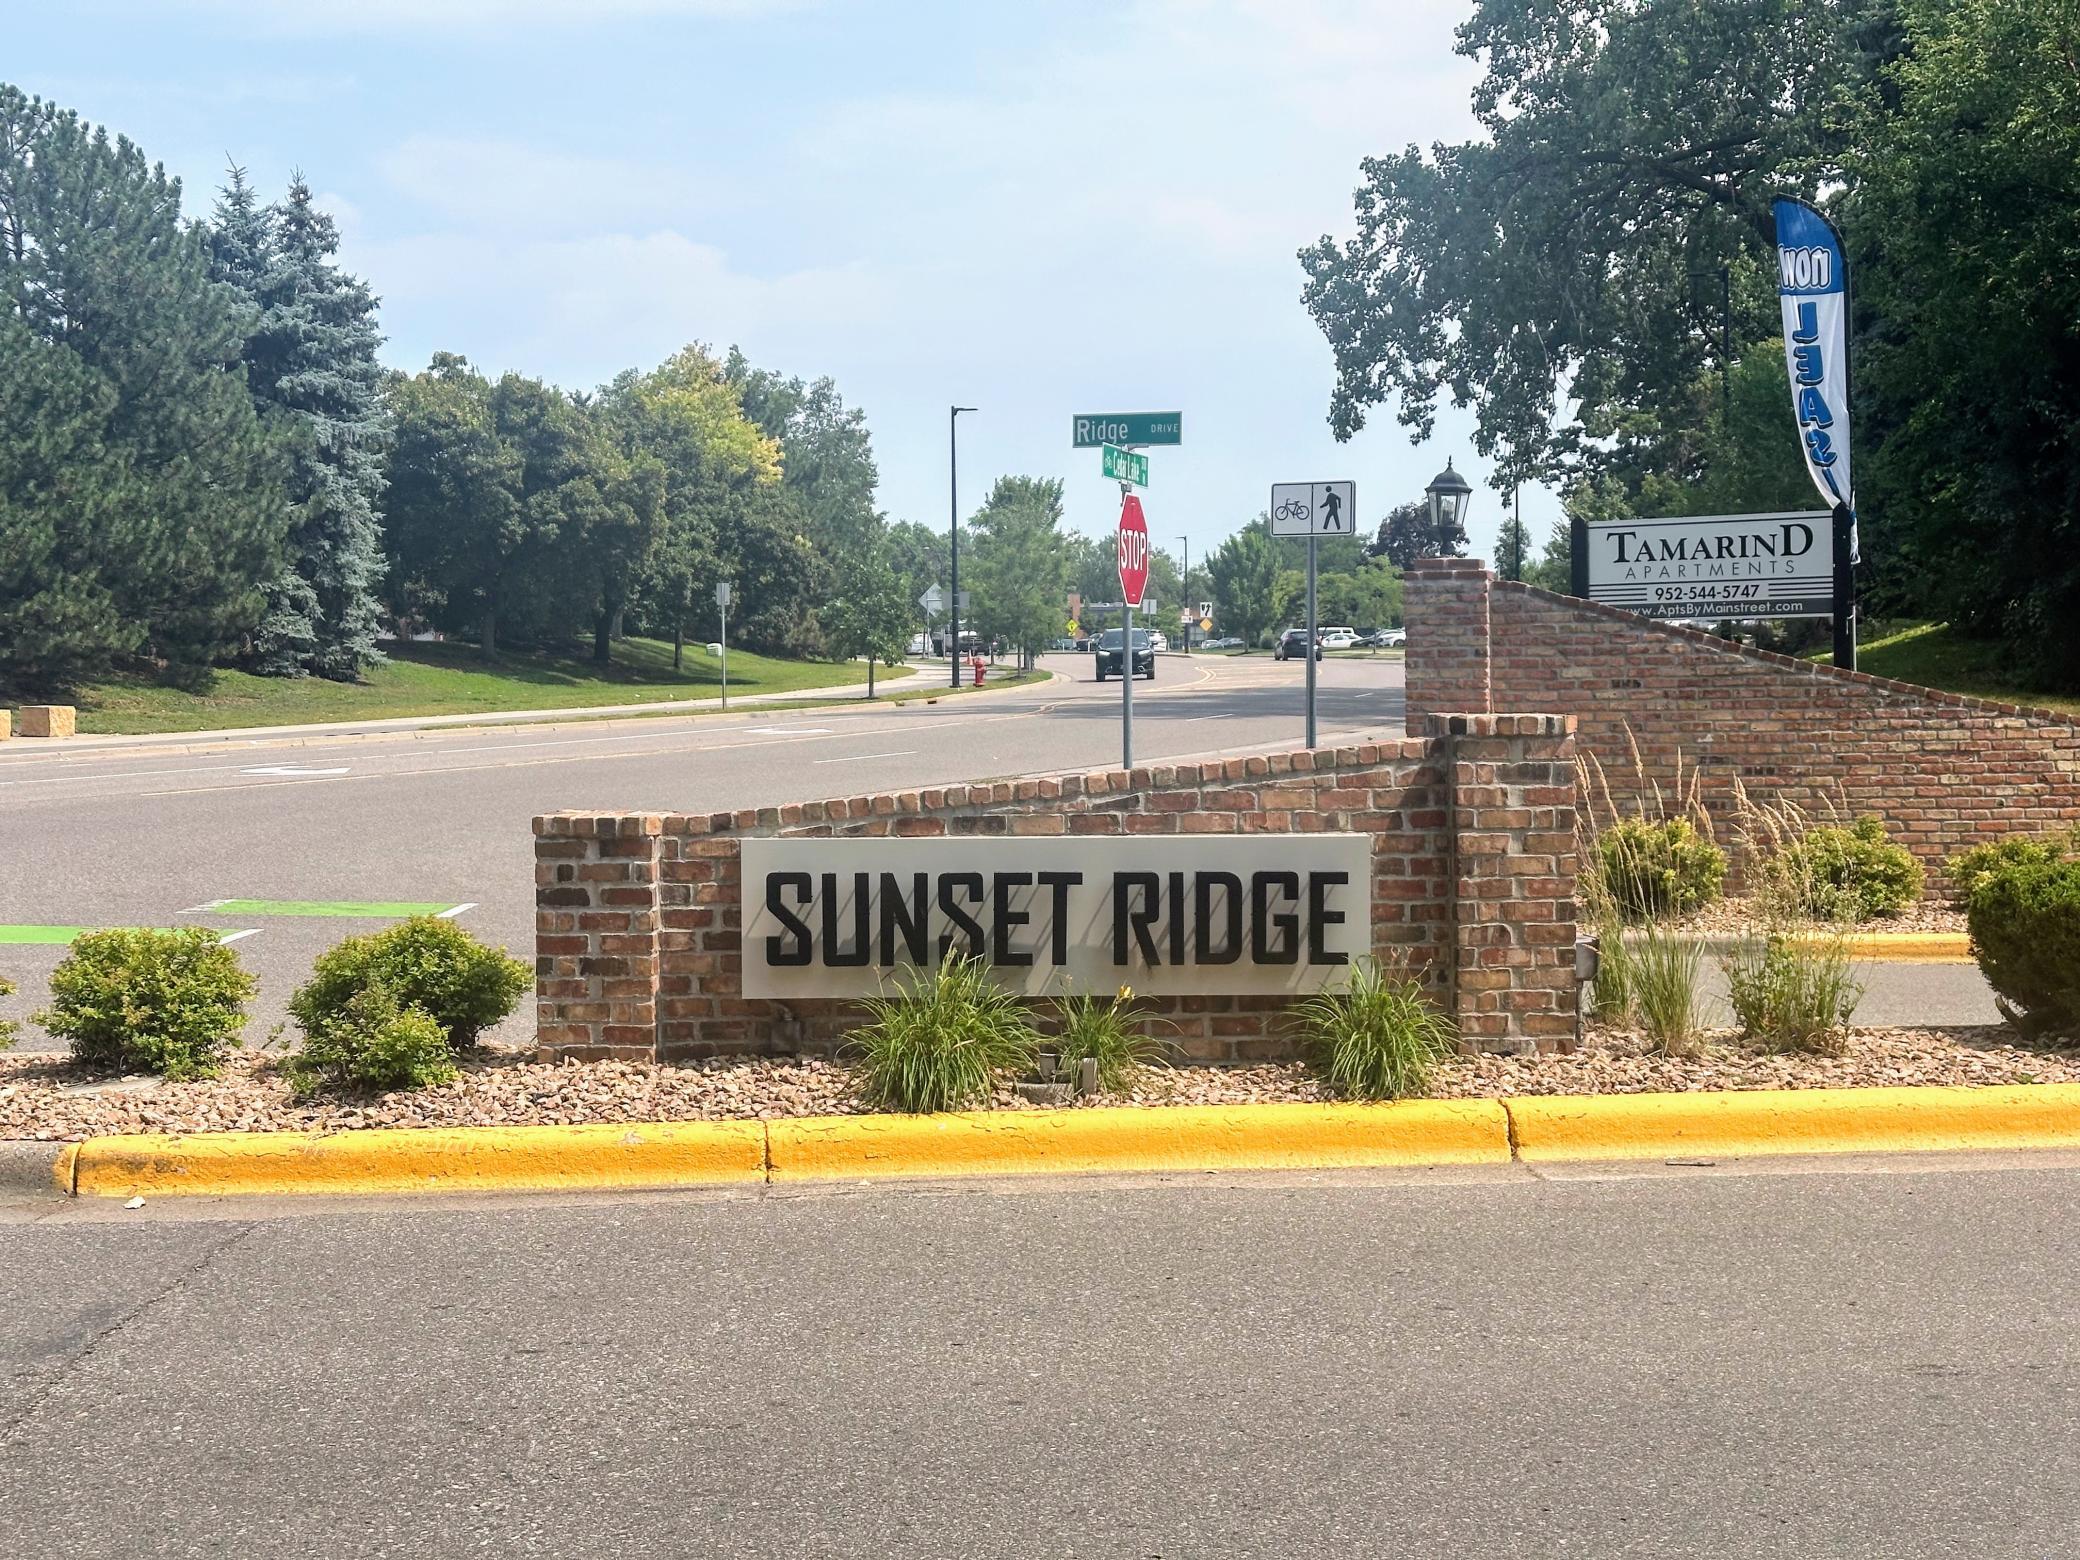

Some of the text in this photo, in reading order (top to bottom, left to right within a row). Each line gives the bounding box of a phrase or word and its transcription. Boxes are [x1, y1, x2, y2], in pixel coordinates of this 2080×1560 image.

[1077, 419, 1178, 444] Ridge DRIVE
[1120, 528, 1146, 571] STOP
[1606, 523, 1813, 563] TAMARIND
[1625, 560, 1795, 580] APARTMENTS
[1655, 584, 1760, 600] 952-544-5747
[766, 871, 1349, 967] SUNSET RIDGE
